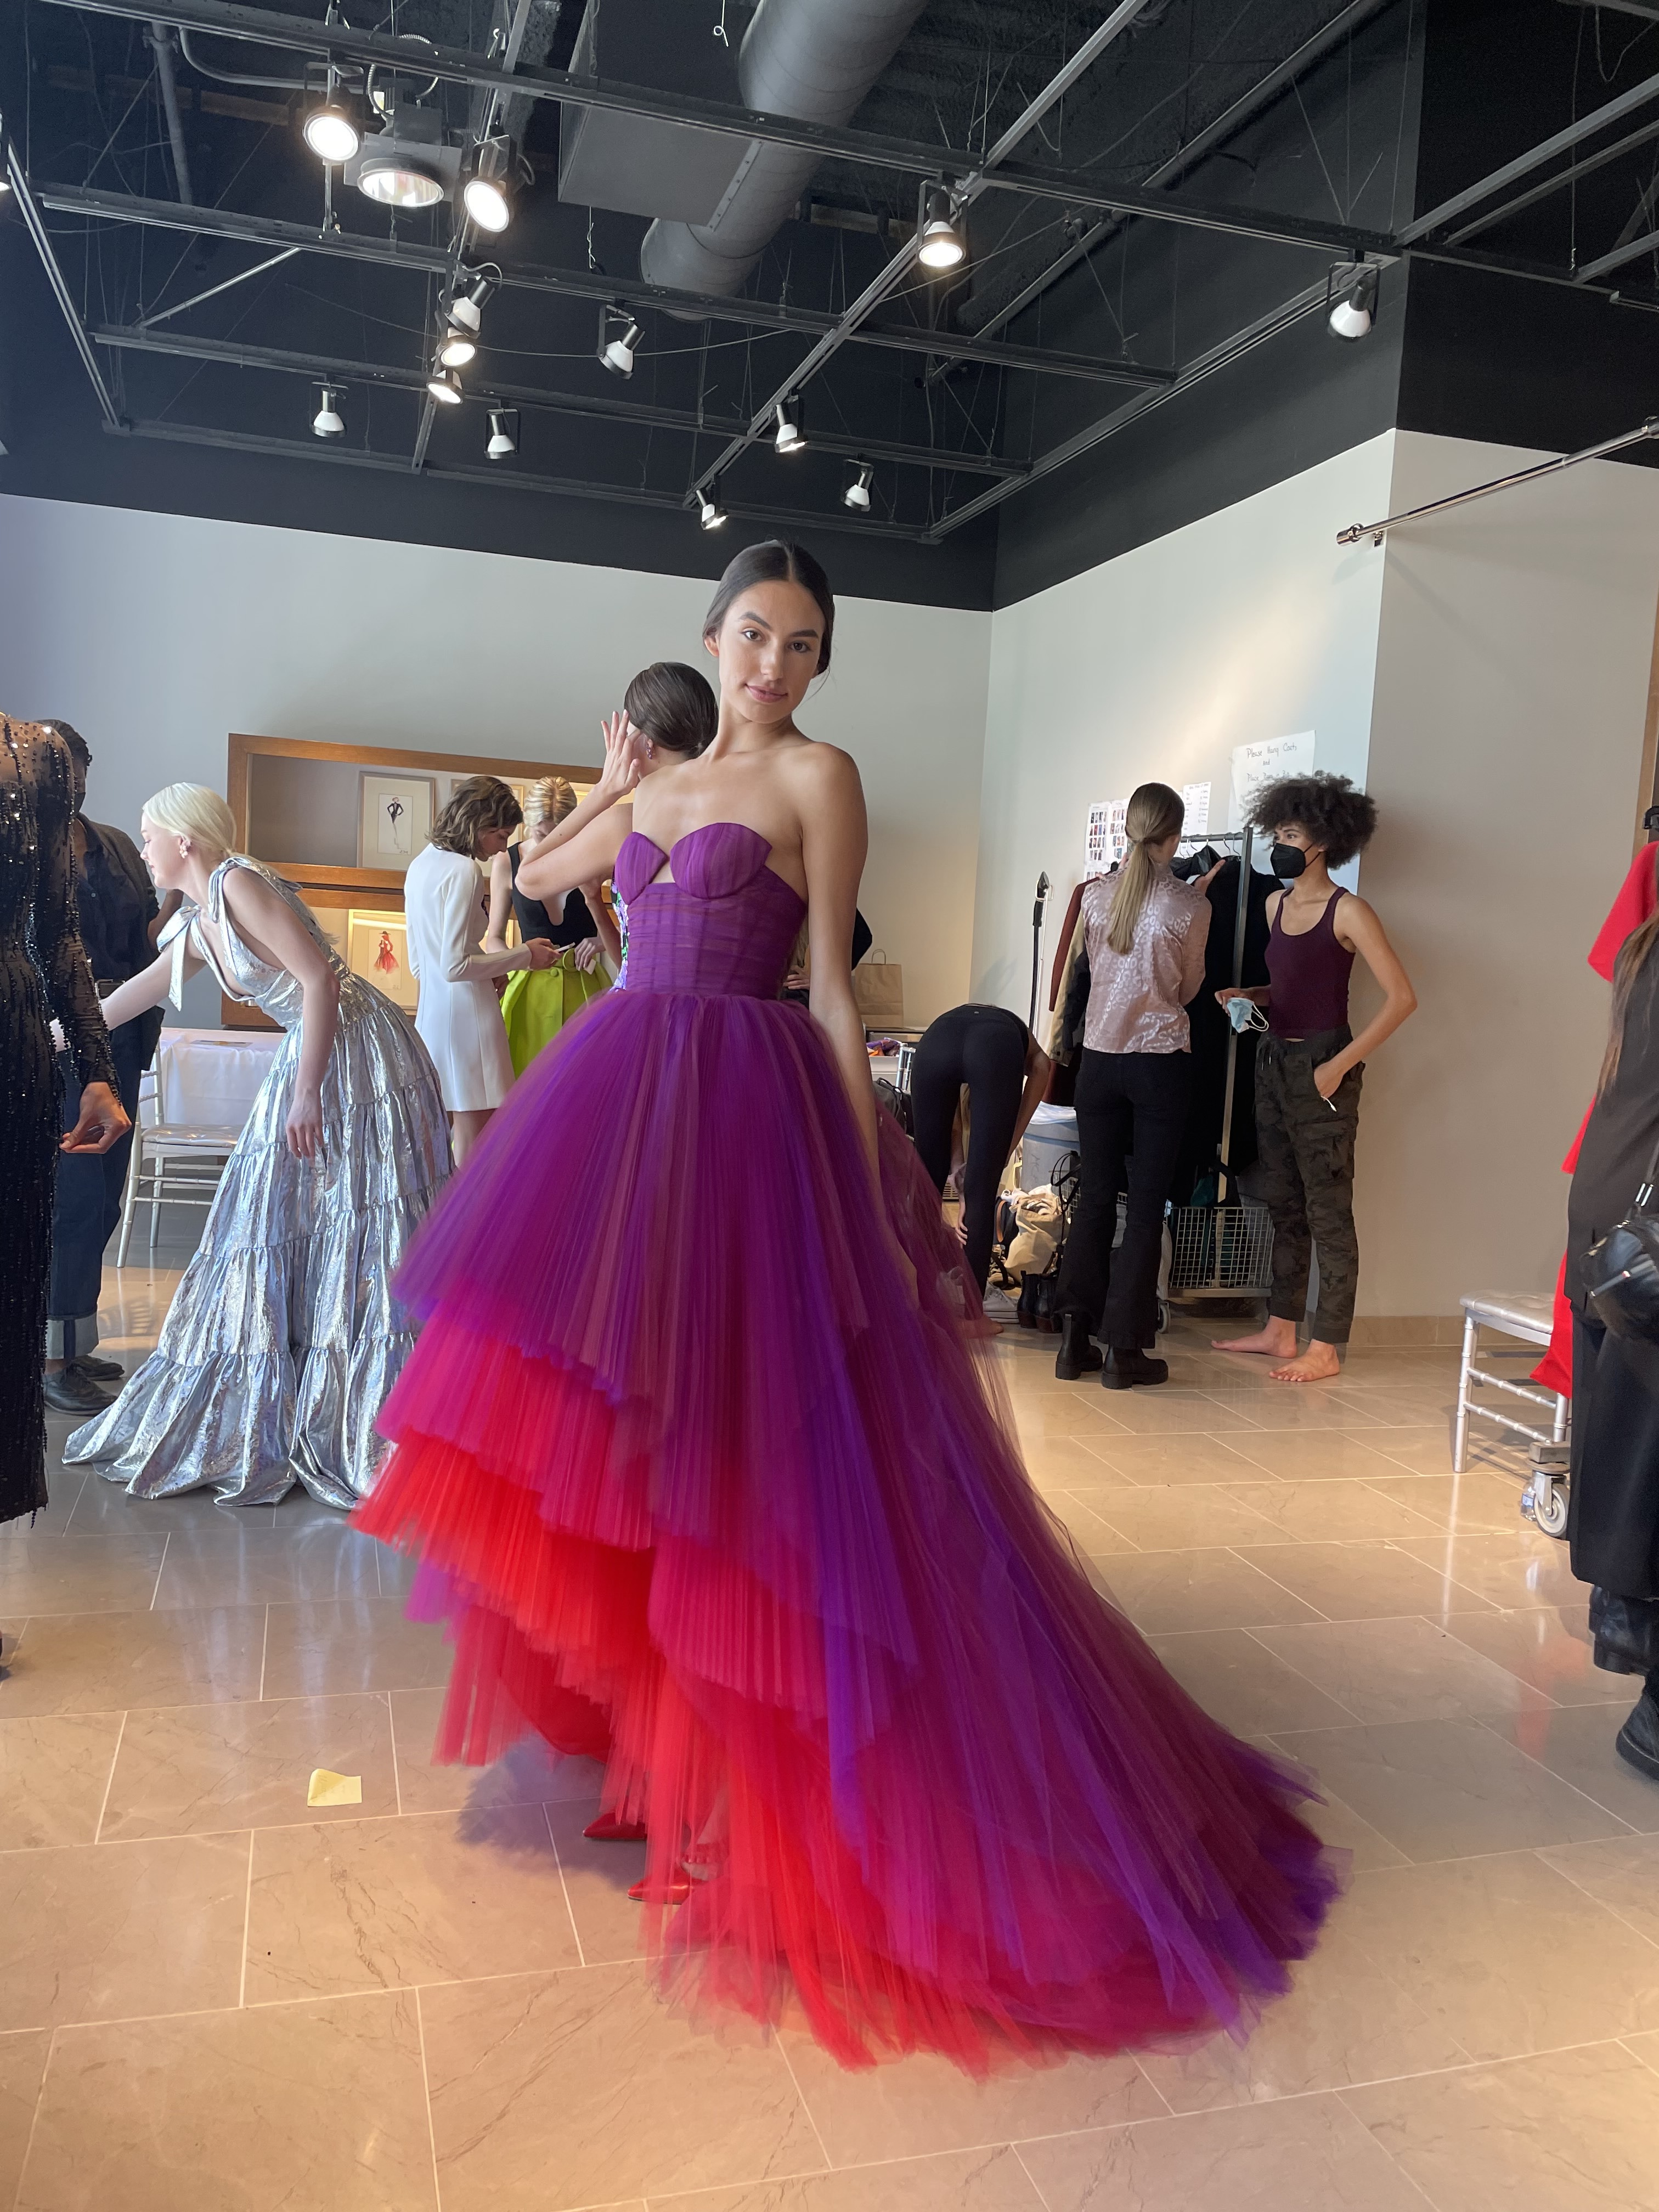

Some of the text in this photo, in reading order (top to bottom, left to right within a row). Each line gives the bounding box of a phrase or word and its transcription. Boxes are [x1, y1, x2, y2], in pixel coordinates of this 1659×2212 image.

[1246, 742, 1297, 758] Please Hang Coats
[1247, 773, 1259, 782] Place
